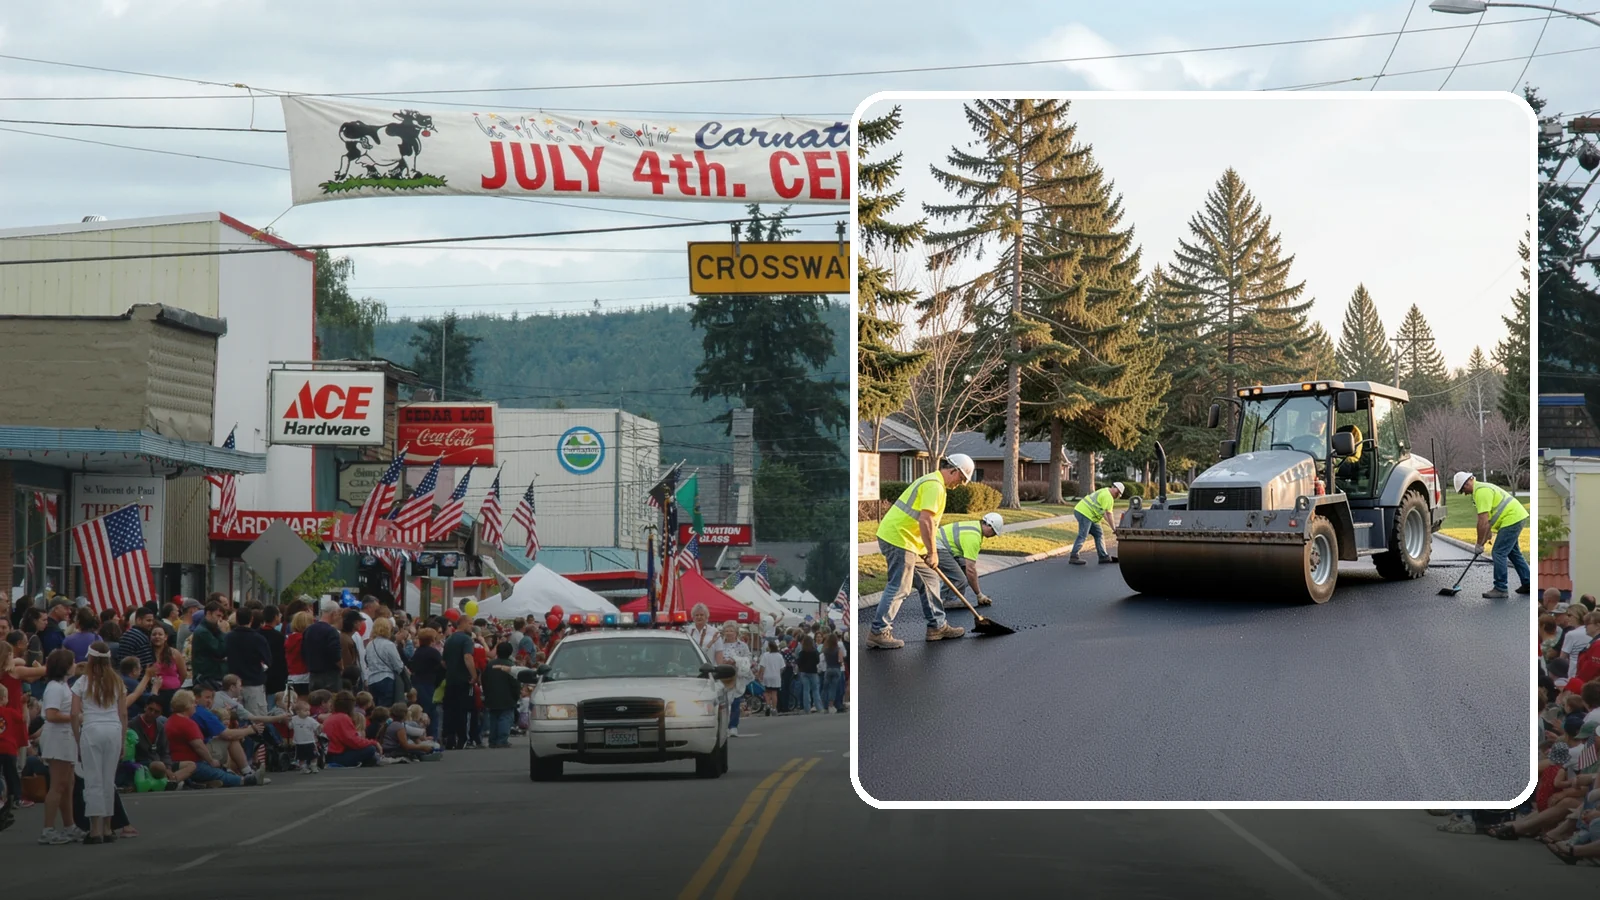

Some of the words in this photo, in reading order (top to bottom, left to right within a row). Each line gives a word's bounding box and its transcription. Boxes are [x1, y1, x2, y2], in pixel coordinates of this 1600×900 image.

[481, 141, 605, 192] JULY
[632, 150, 746, 198] 4th.
[697, 254, 850, 280] CROSSWA
[283, 380, 373, 420] ACE
[405, 409, 453, 422] CEDAR
[284, 421, 370, 437] Hardware
[416, 428, 476, 447] Coca-Cola
[83, 485, 93, 494] St.
[95, 485, 124, 495] Vincent
[126, 486, 136, 495] de
[137, 486, 155, 495] Paul
[688, 526, 741, 535] CRNATION
[699, 535, 730, 543] GLASS
